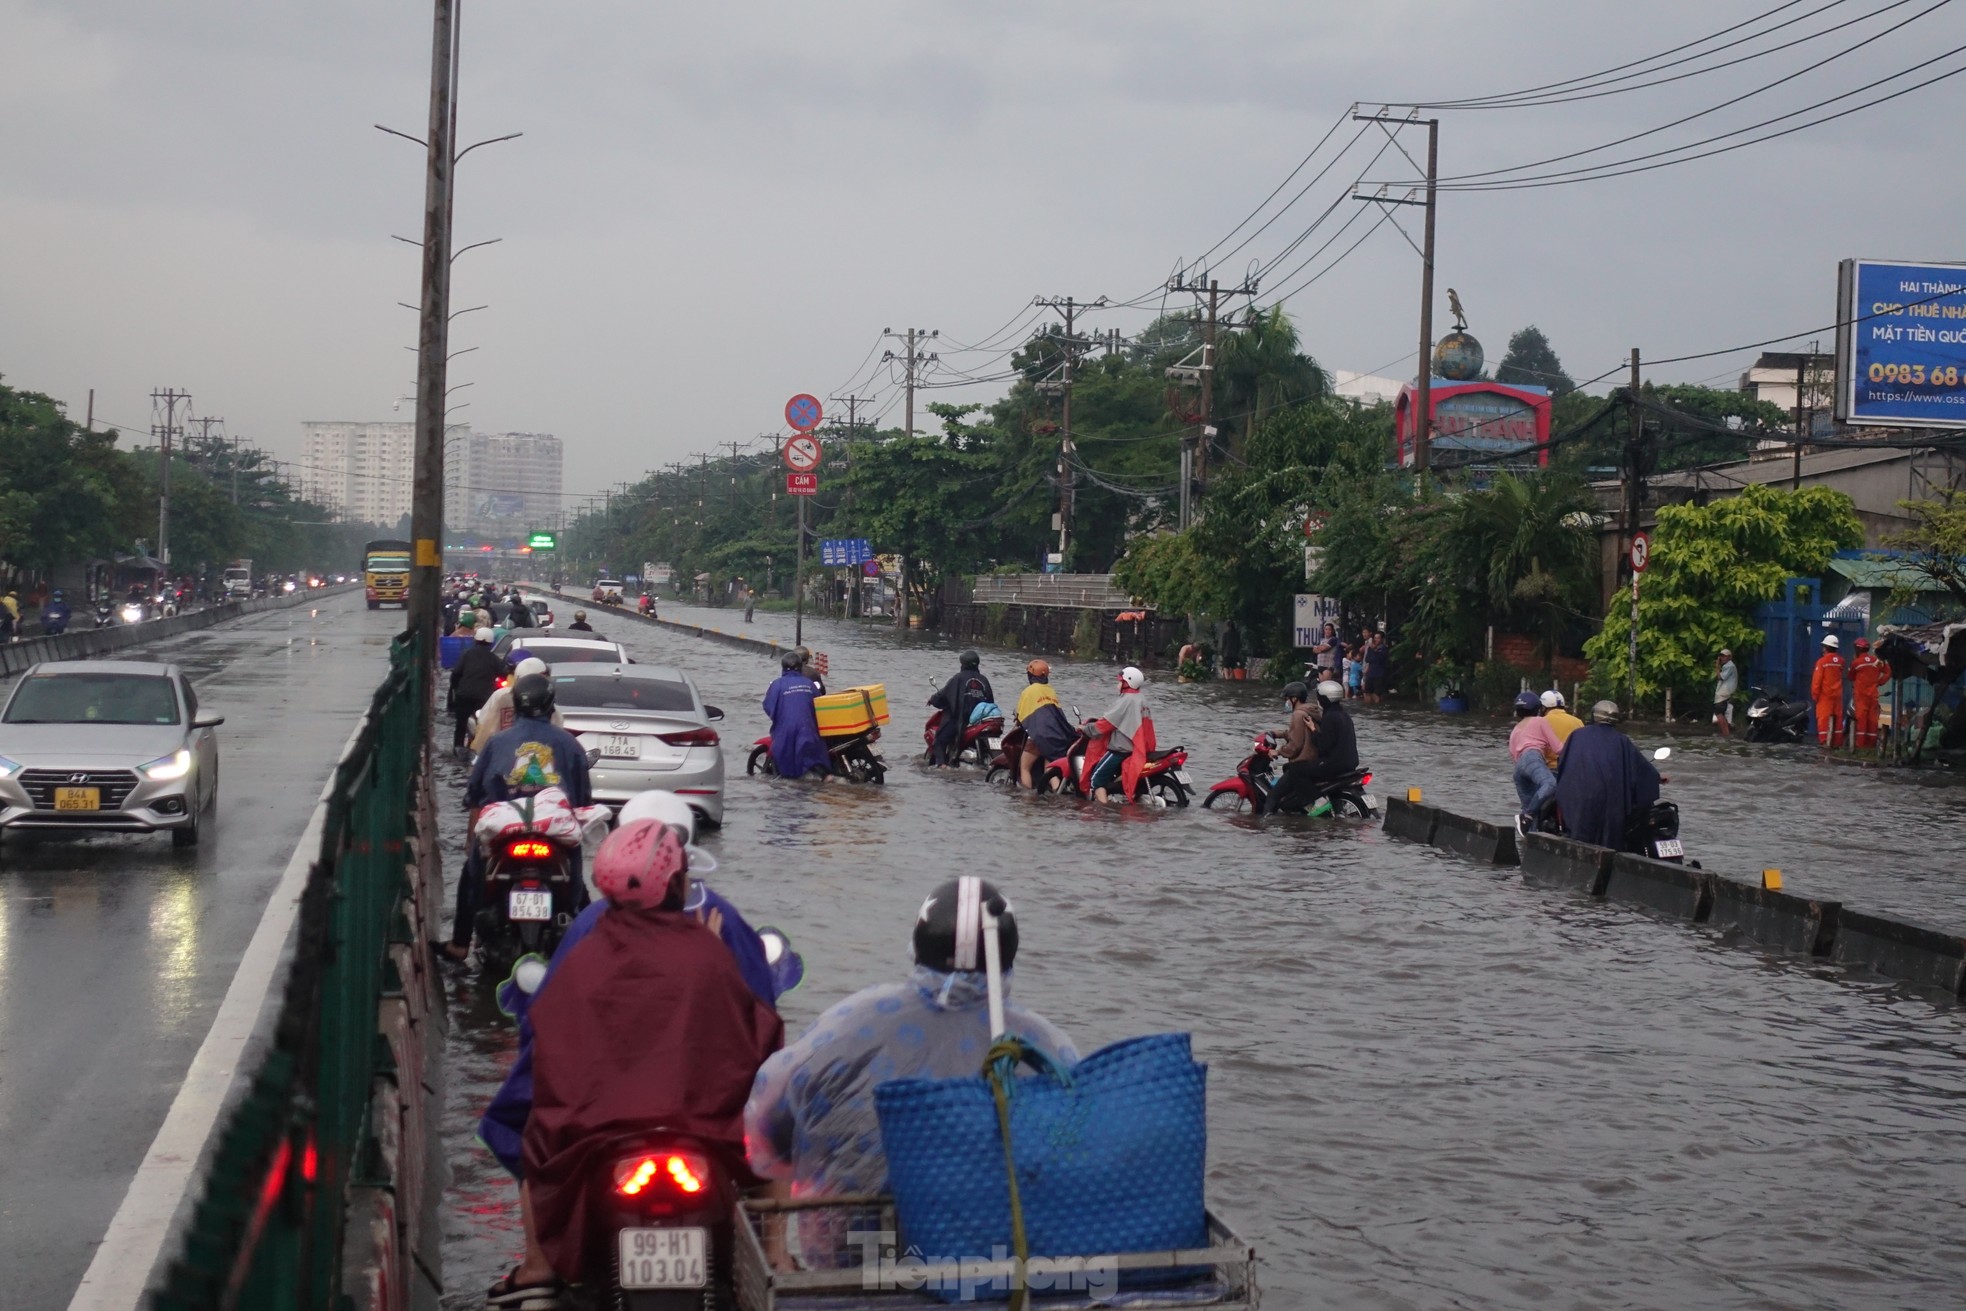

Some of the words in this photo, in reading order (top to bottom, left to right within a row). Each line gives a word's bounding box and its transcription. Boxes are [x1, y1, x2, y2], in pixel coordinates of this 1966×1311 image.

[1900, 281, 1920, 293] HAI
[1922, 280, 1961, 295] THÀNH
[1872, 302, 1904, 316] CHO
[1908, 302, 1940, 318] THUÊ
[1872, 324, 1903, 344] MẶT
[1906, 323, 1935, 342] TIỀN
[1868, 362, 1926, 385] 0983
[1930, 365, 1958, 387] 68
[611, 736, 629, 746] 71A
[604, 745, 636, 756] 168.45
[634, 1232, 690, 1256] 99-H1
[627, 1258, 701, 1284] 103.04
